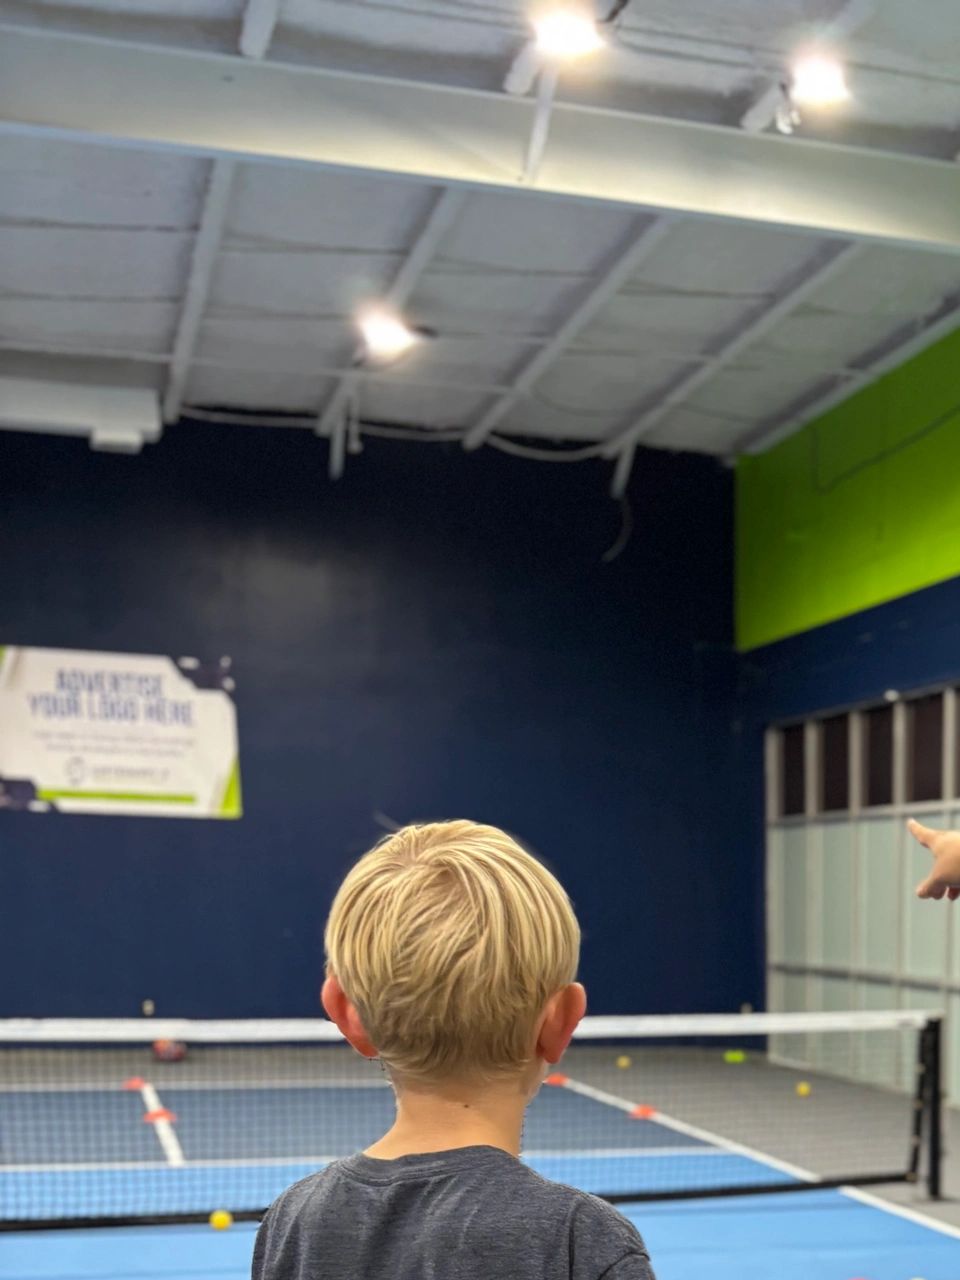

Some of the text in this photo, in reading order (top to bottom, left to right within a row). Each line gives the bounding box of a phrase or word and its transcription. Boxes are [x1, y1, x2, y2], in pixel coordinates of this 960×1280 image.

[30, 693, 193, 726] YOUR LOGO HERE
